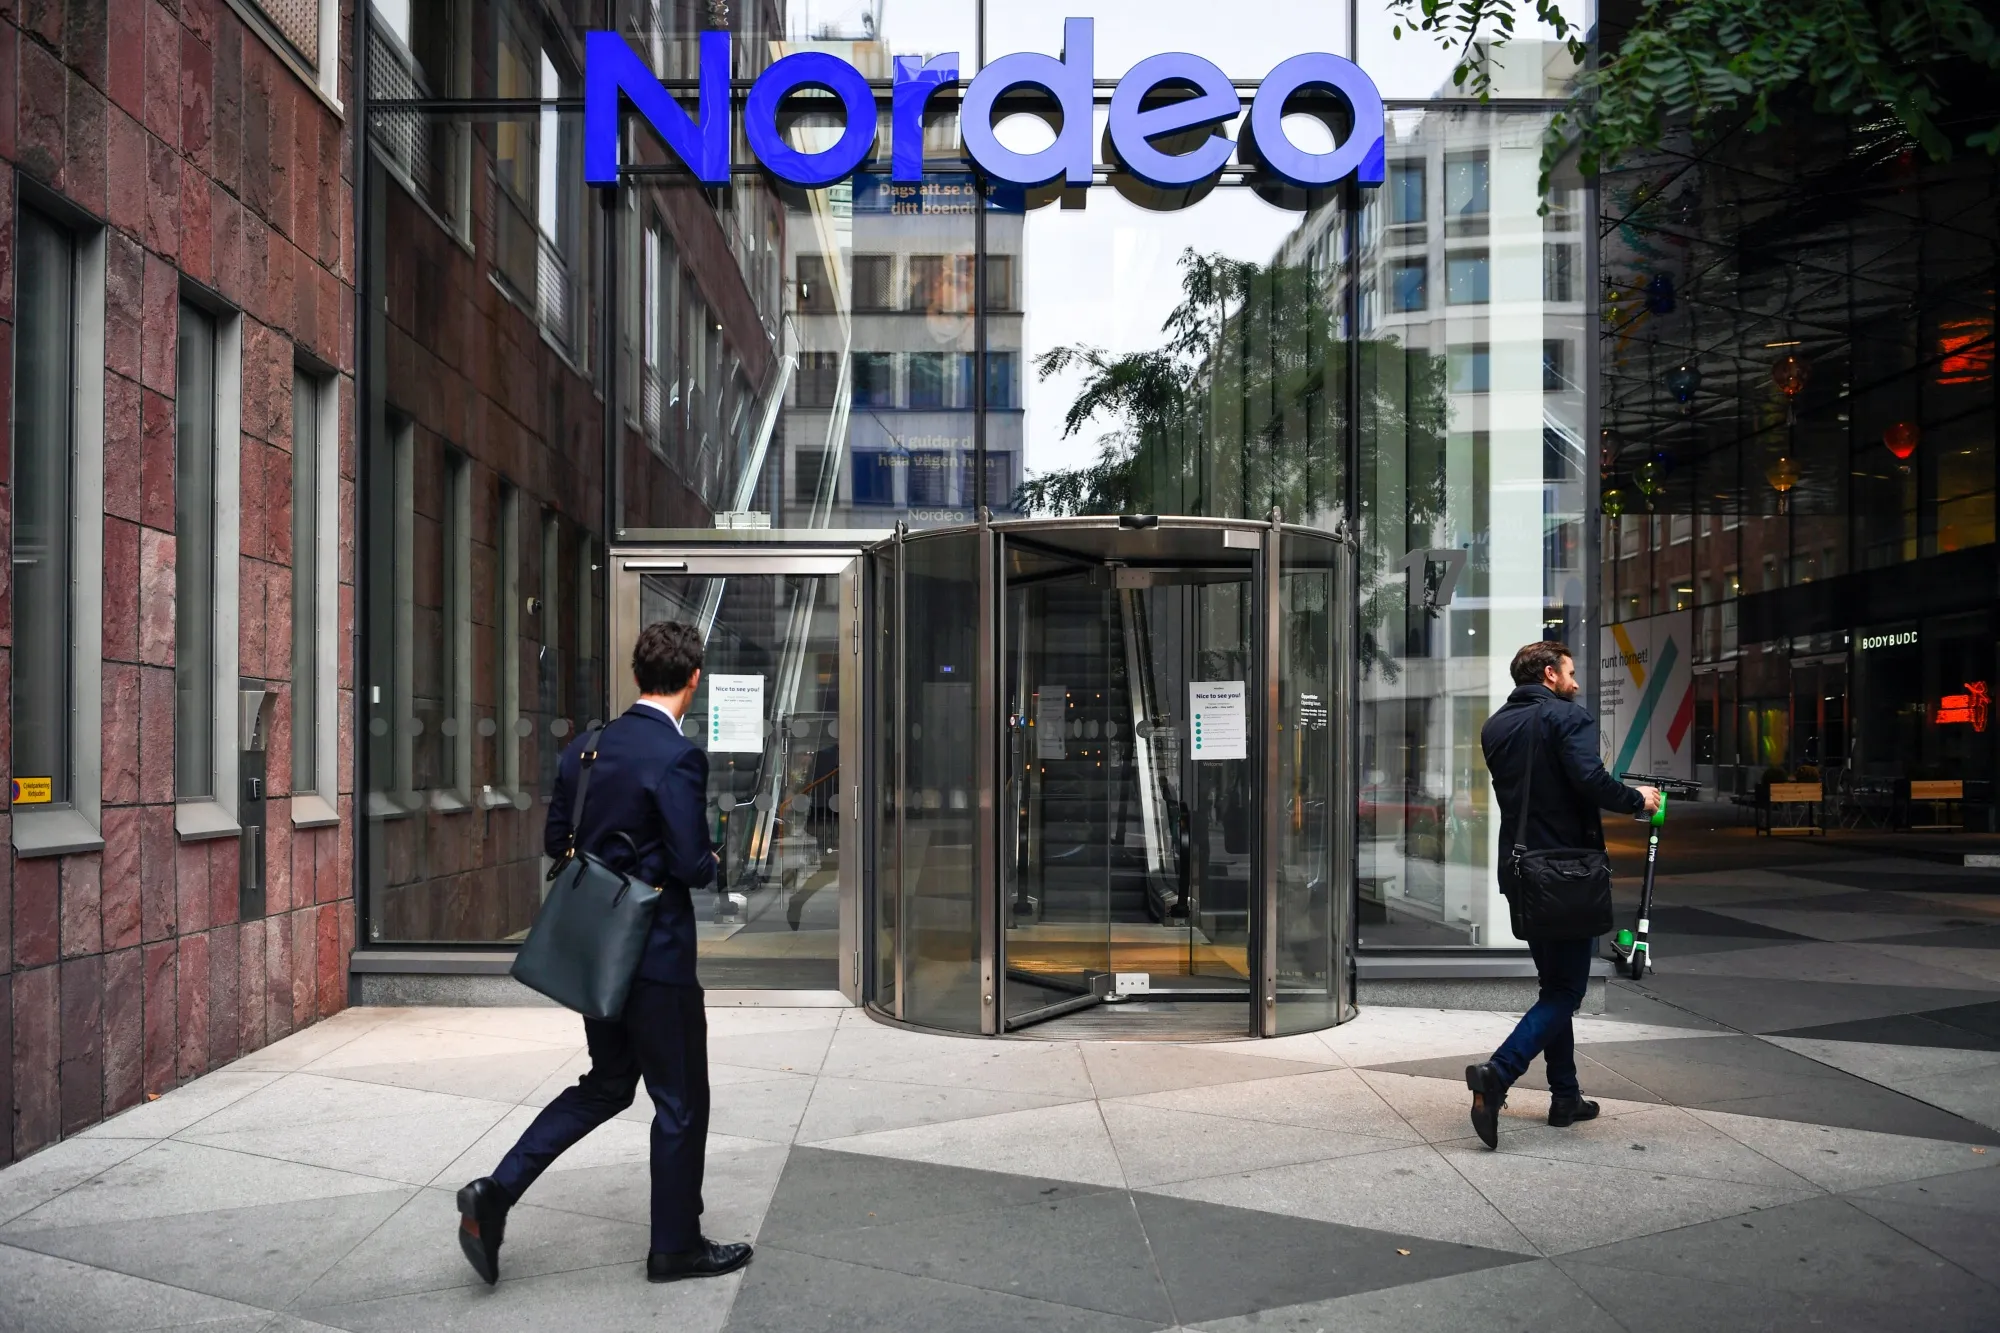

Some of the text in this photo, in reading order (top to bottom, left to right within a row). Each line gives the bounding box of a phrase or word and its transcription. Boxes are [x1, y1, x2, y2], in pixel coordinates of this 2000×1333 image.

[585, 17, 1385, 187] Nordea
[879, 182, 997, 198] Dags att se ör
[892, 202, 918, 215] ditt
[909, 435, 957, 449] guidar
[878, 454, 910, 467] hela
[914, 455, 958, 469] vägen
[908, 509, 964, 521] Nordea
[1400, 548, 1467, 606] 17
[1601, 647, 1648, 669] runt hörnet!
